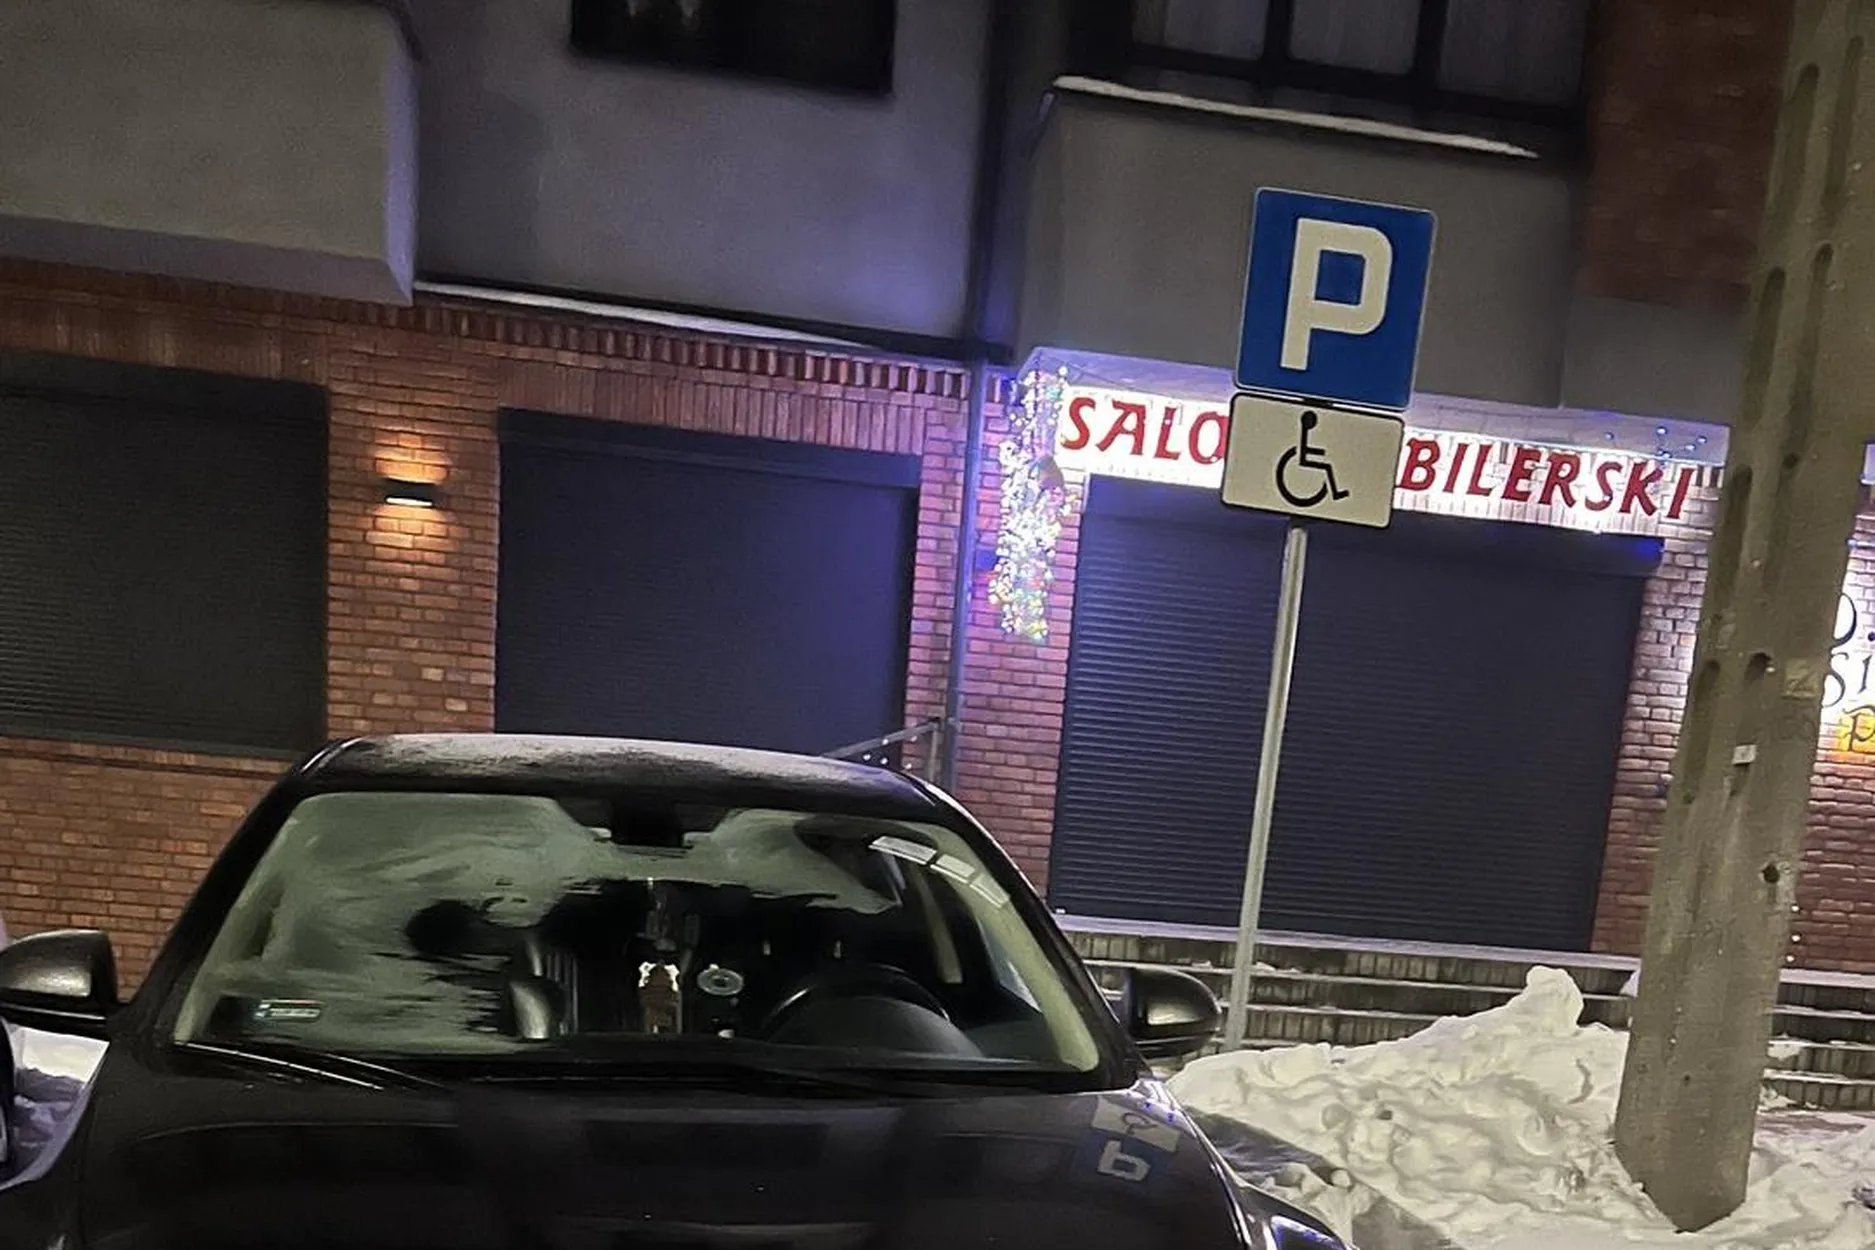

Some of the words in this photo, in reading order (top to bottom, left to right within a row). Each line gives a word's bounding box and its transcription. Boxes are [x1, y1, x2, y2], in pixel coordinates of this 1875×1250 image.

[1280, 217, 1393, 371] P
[1060, 396, 1230, 466] SALO
[1399, 437, 1695, 519] BILERSKI
